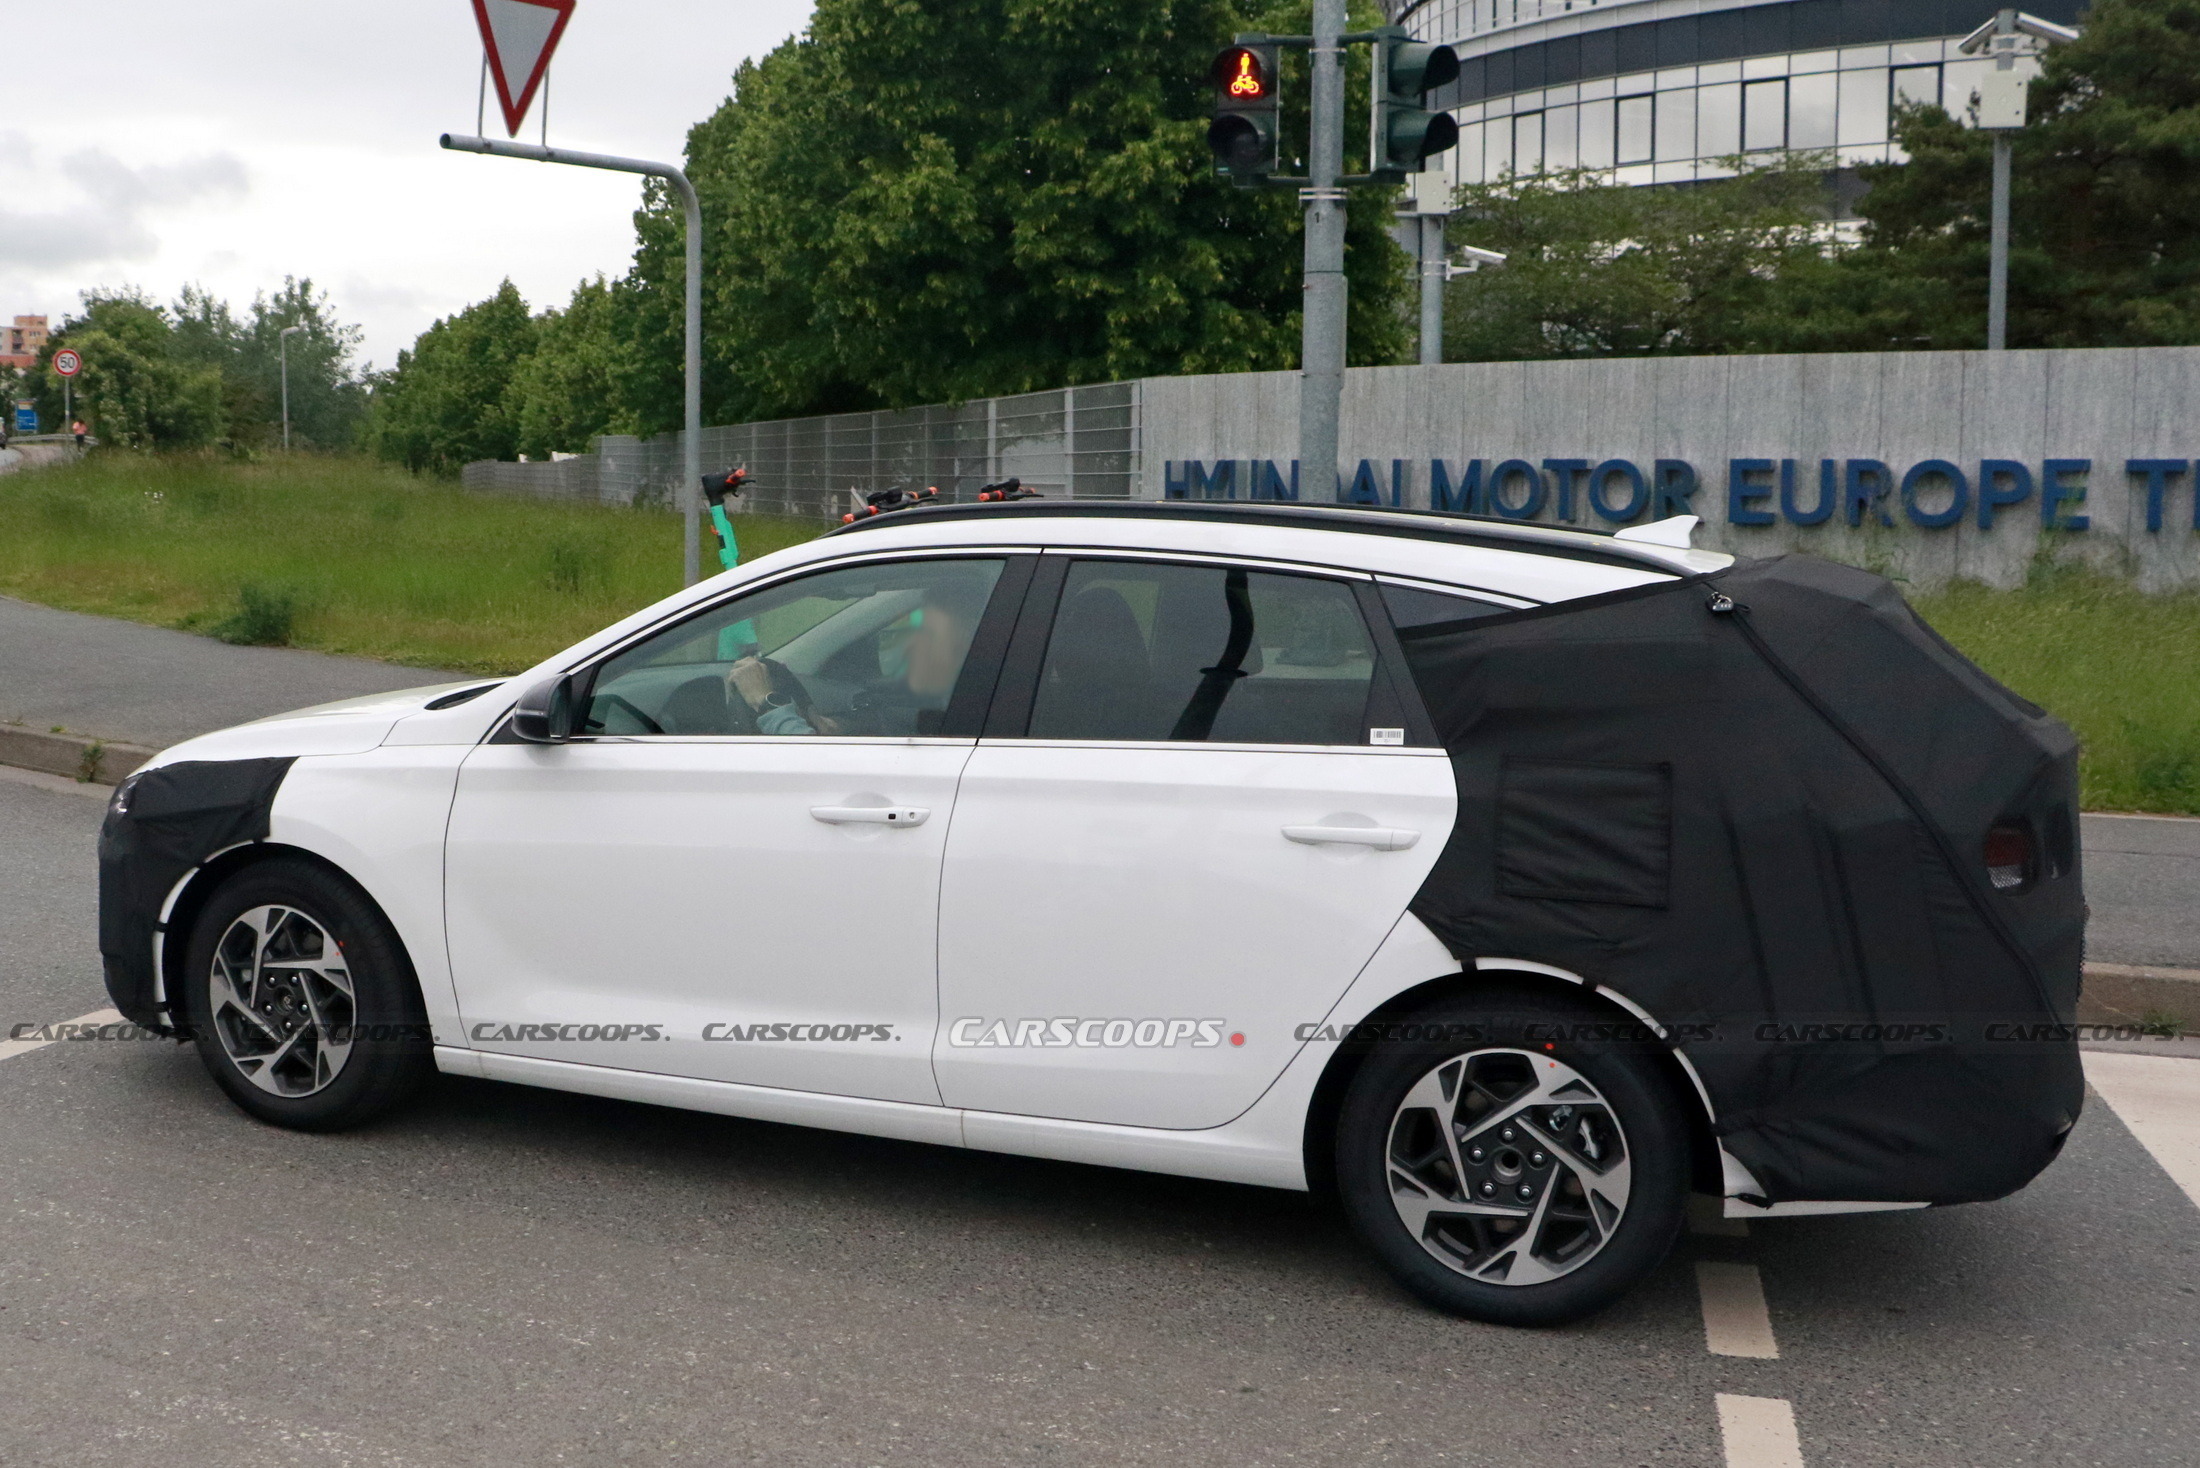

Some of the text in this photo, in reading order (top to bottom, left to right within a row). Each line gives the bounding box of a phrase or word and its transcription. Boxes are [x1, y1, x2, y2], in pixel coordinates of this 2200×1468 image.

[59, 356, 75, 369] 50
[1164, 458, 2200, 532] HYUNAI MOTOR EUROPE T
